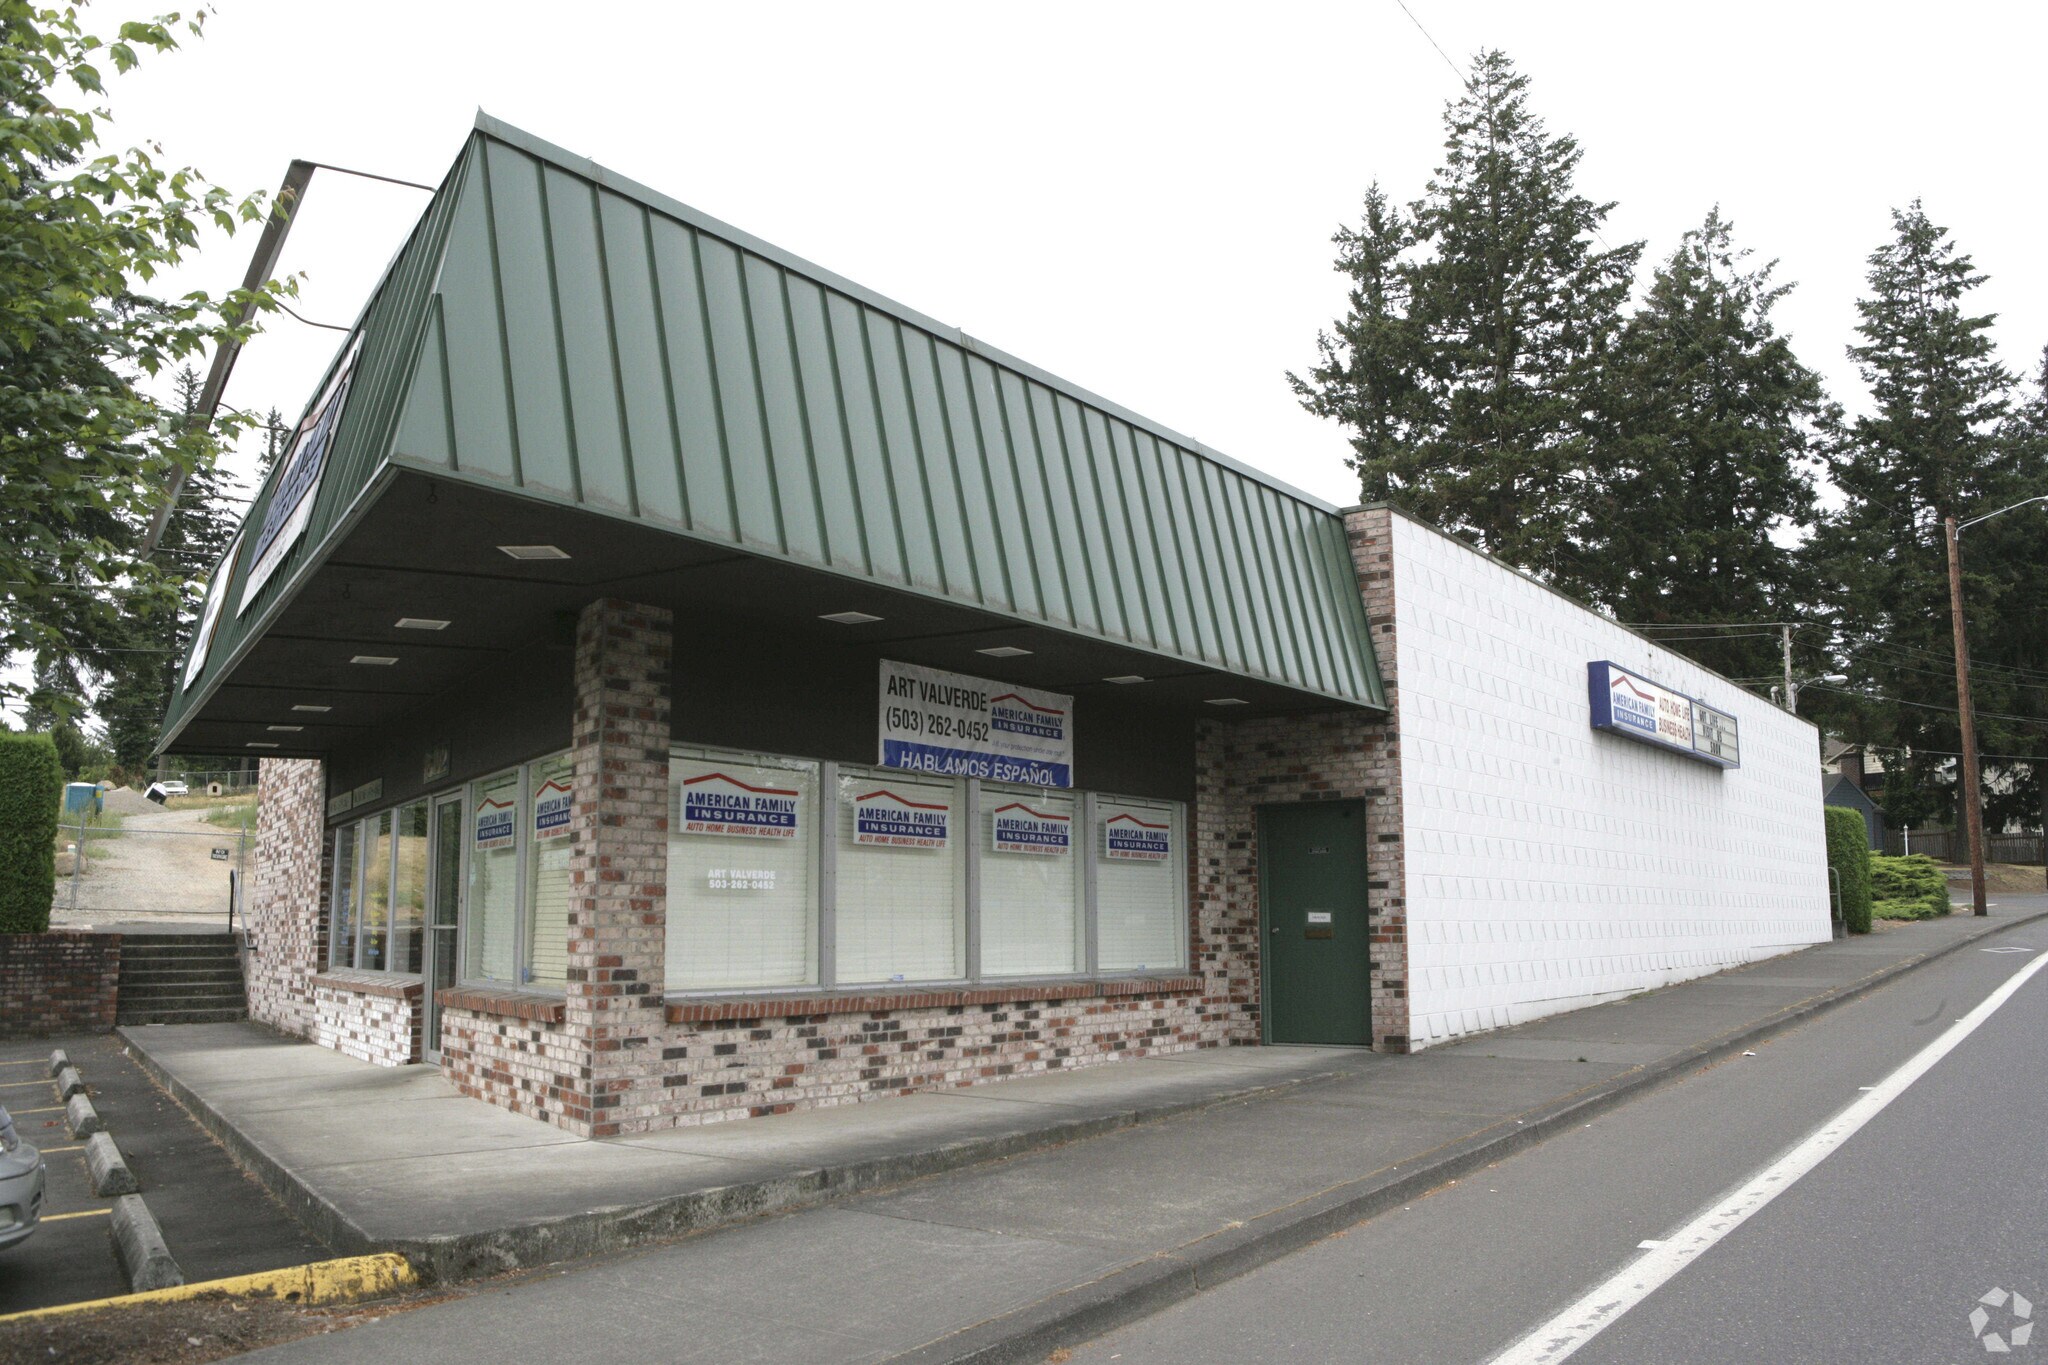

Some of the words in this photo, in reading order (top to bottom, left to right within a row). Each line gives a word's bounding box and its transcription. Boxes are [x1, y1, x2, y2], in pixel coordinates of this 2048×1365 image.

[887, 675, 916, 699] ART
[919, 681, 987, 712] VALVERDE
[1613, 691, 1638, 712] AMERICAN
[1638, 701, 1655, 718] FAMILY
[1659, 696, 1669, 713] AUTO
[1670, 701, 1681, 718] HOME
[1682, 704, 1690, 721] LIFE
[886, 706, 924, 736] (503)
[928, 714, 989, 742] 262-0452
[992, 706, 1033, 723] AMERICAN
[1036, 714, 1063, 727] FAMILY
[1616, 709, 1653, 729] INSURANCE
[998, 721, 1058, 737] INSURANCE
[1659, 717, 1676, 737] BUSINESS
[900, 750, 989, 776] HABLAMOS
[993, 763, 1056, 786] ESPAÑOL
[537, 798, 561, 815] AMERICAN
[686, 792, 750, 809] AMERICAN
[755, 798, 795, 812] FAMILY
[539, 811, 571, 826] INSURANC
[694, 809, 788, 824] INSURANCE
[859, 807, 909, 823] AMERICAN
[914, 812, 946, 825] FAMILY
[480, 825, 510, 838] INSURANCE
[686, 822, 704, 831] AUTO
[706, 823, 725, 833] HOME
[727, 825, 756, 835] BUSINESS
[759, 827, 781, 836] HEALTH
[783, 829, 795, 837] LIFE
[865, 822, 941, 835] INSURANCE
[997, 818, 1038, 832] AMERICAN
[1041, 822, 1068, 834] FAMILY
[859, 834, 873, 843] AUTO
[874, 835, 889, 844] HOME
[891, 836, 915, 846] BUSINESS
[917, 839, 935, 847] HEALTH
[935, 840, 946, 848] LIFE
[1002, 832, 1063, 844] INSURANCE
[1109, 828, 1143, 840] AMERICAN
[1146, 831, 1168, 841] FAMILY
[1114, 840, 1164, 850] INSURANCE
[708, 869, 726, 879] ART
[730, 869, 776, 880] VALVERDE
[709, 879, 775, 889] 503-262-0452
